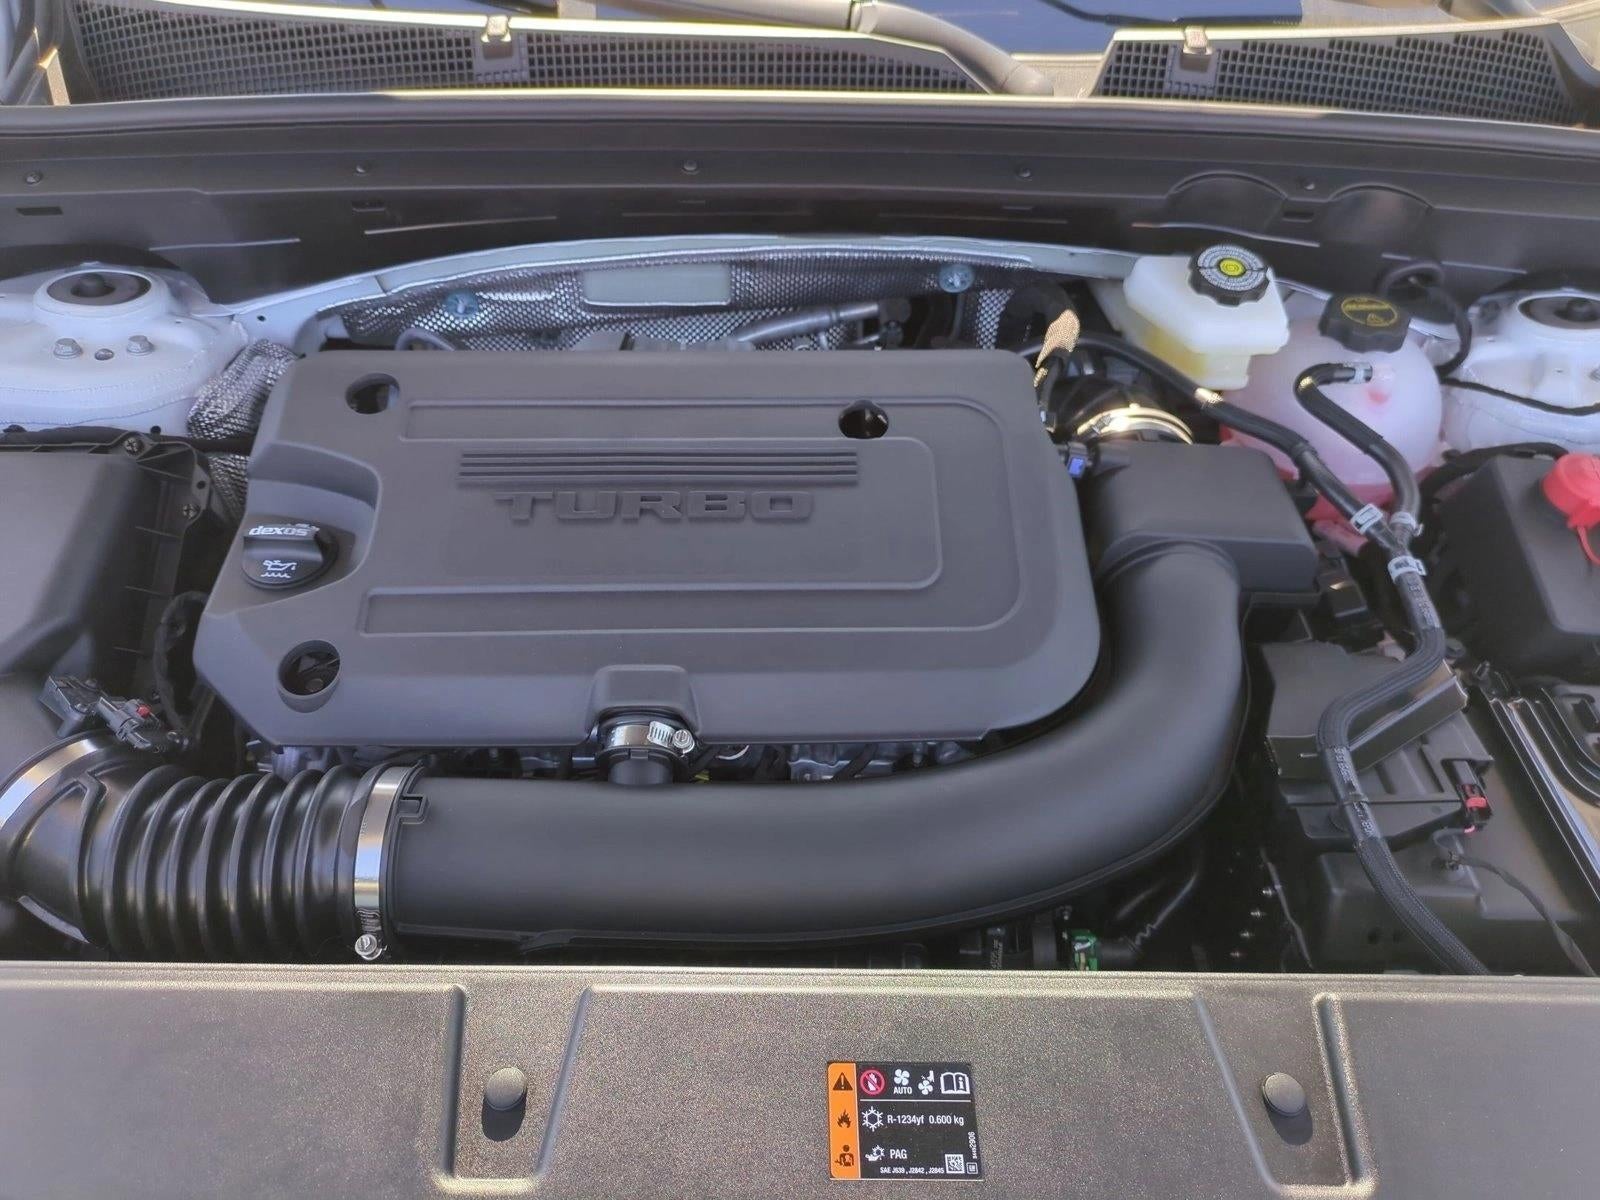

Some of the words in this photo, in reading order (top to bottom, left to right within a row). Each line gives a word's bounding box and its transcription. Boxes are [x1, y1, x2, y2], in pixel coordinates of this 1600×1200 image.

[495, 491, 813, 522] TURBO
[248, 525, 310, 537] dexos
[893, 1086, 912, 1095] AUTO
[887, 1115, 924, 1126] R-1234yf
[928, 1115, 951, 1124] 0.600
[953, 1115, 964, 1126] kg
[889, 1149, 908, 1160] PAG
